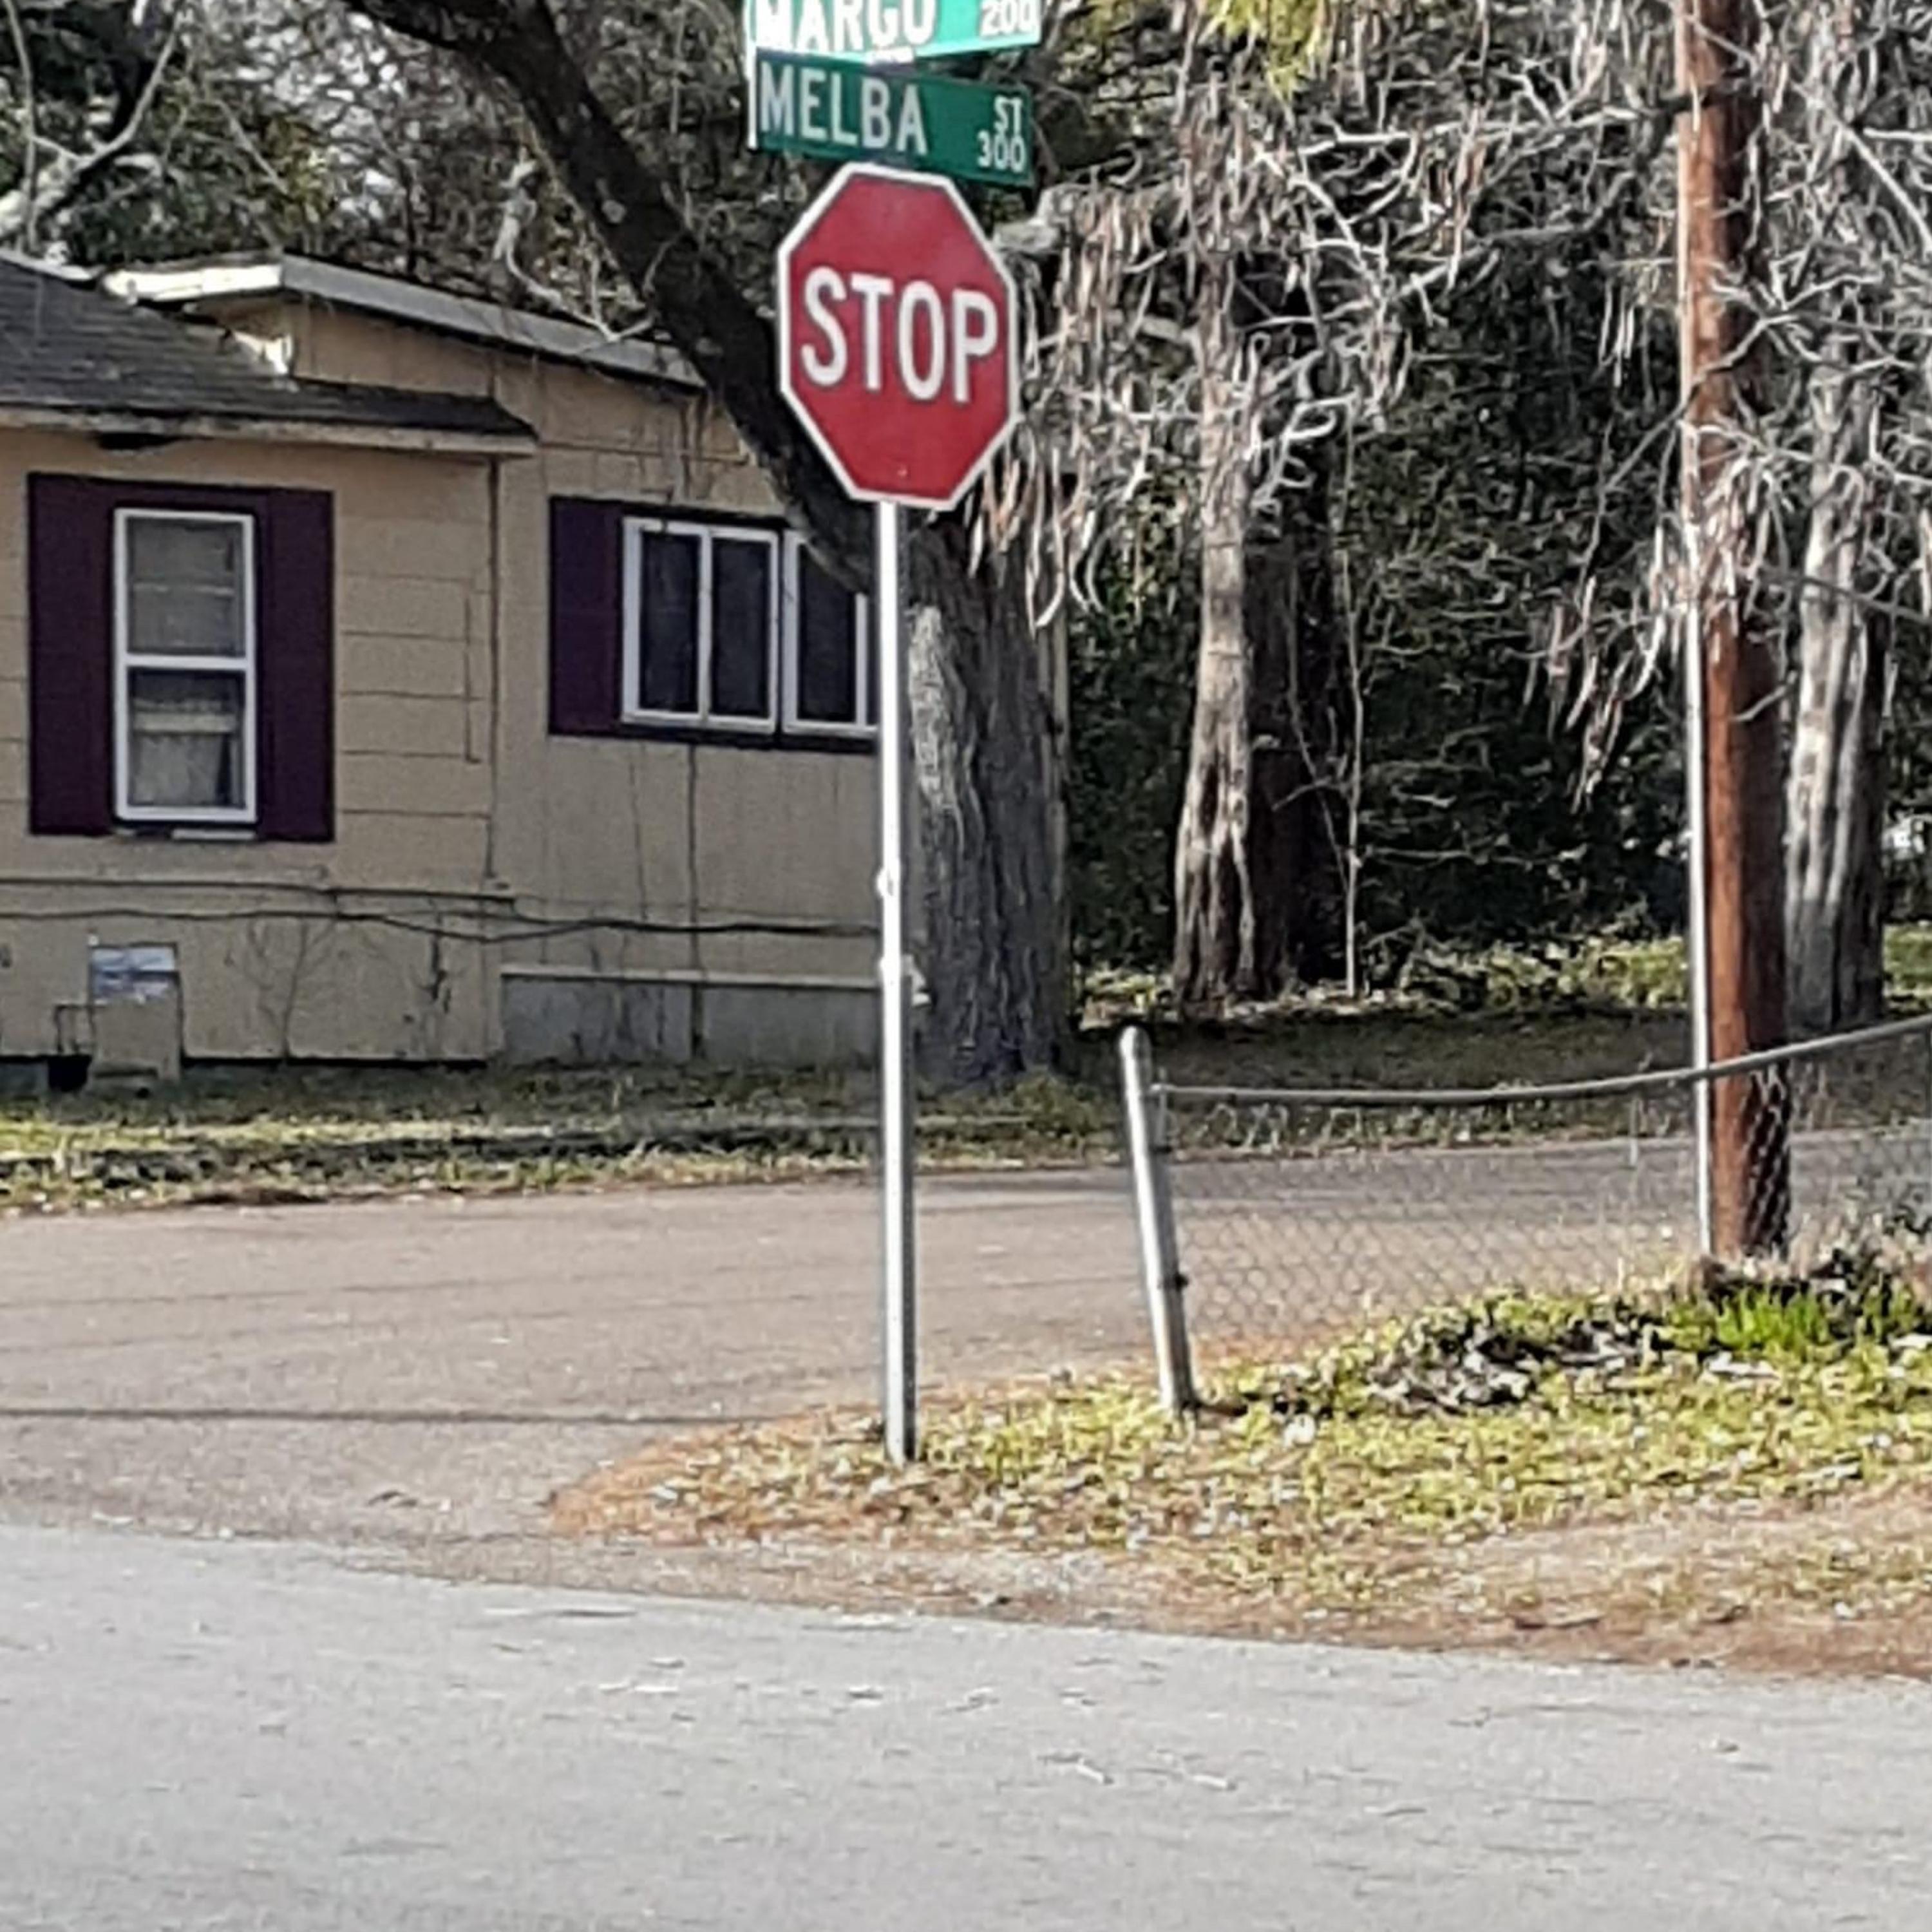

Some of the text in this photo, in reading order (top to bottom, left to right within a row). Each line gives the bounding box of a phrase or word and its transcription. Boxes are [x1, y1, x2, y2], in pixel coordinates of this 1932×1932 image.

[760, 62, 928, 155] MELBA
[994, 96, 1022, 134] ST
[977, 130, 1026, 173] 300
[801, 266, 998, 404] STOP
